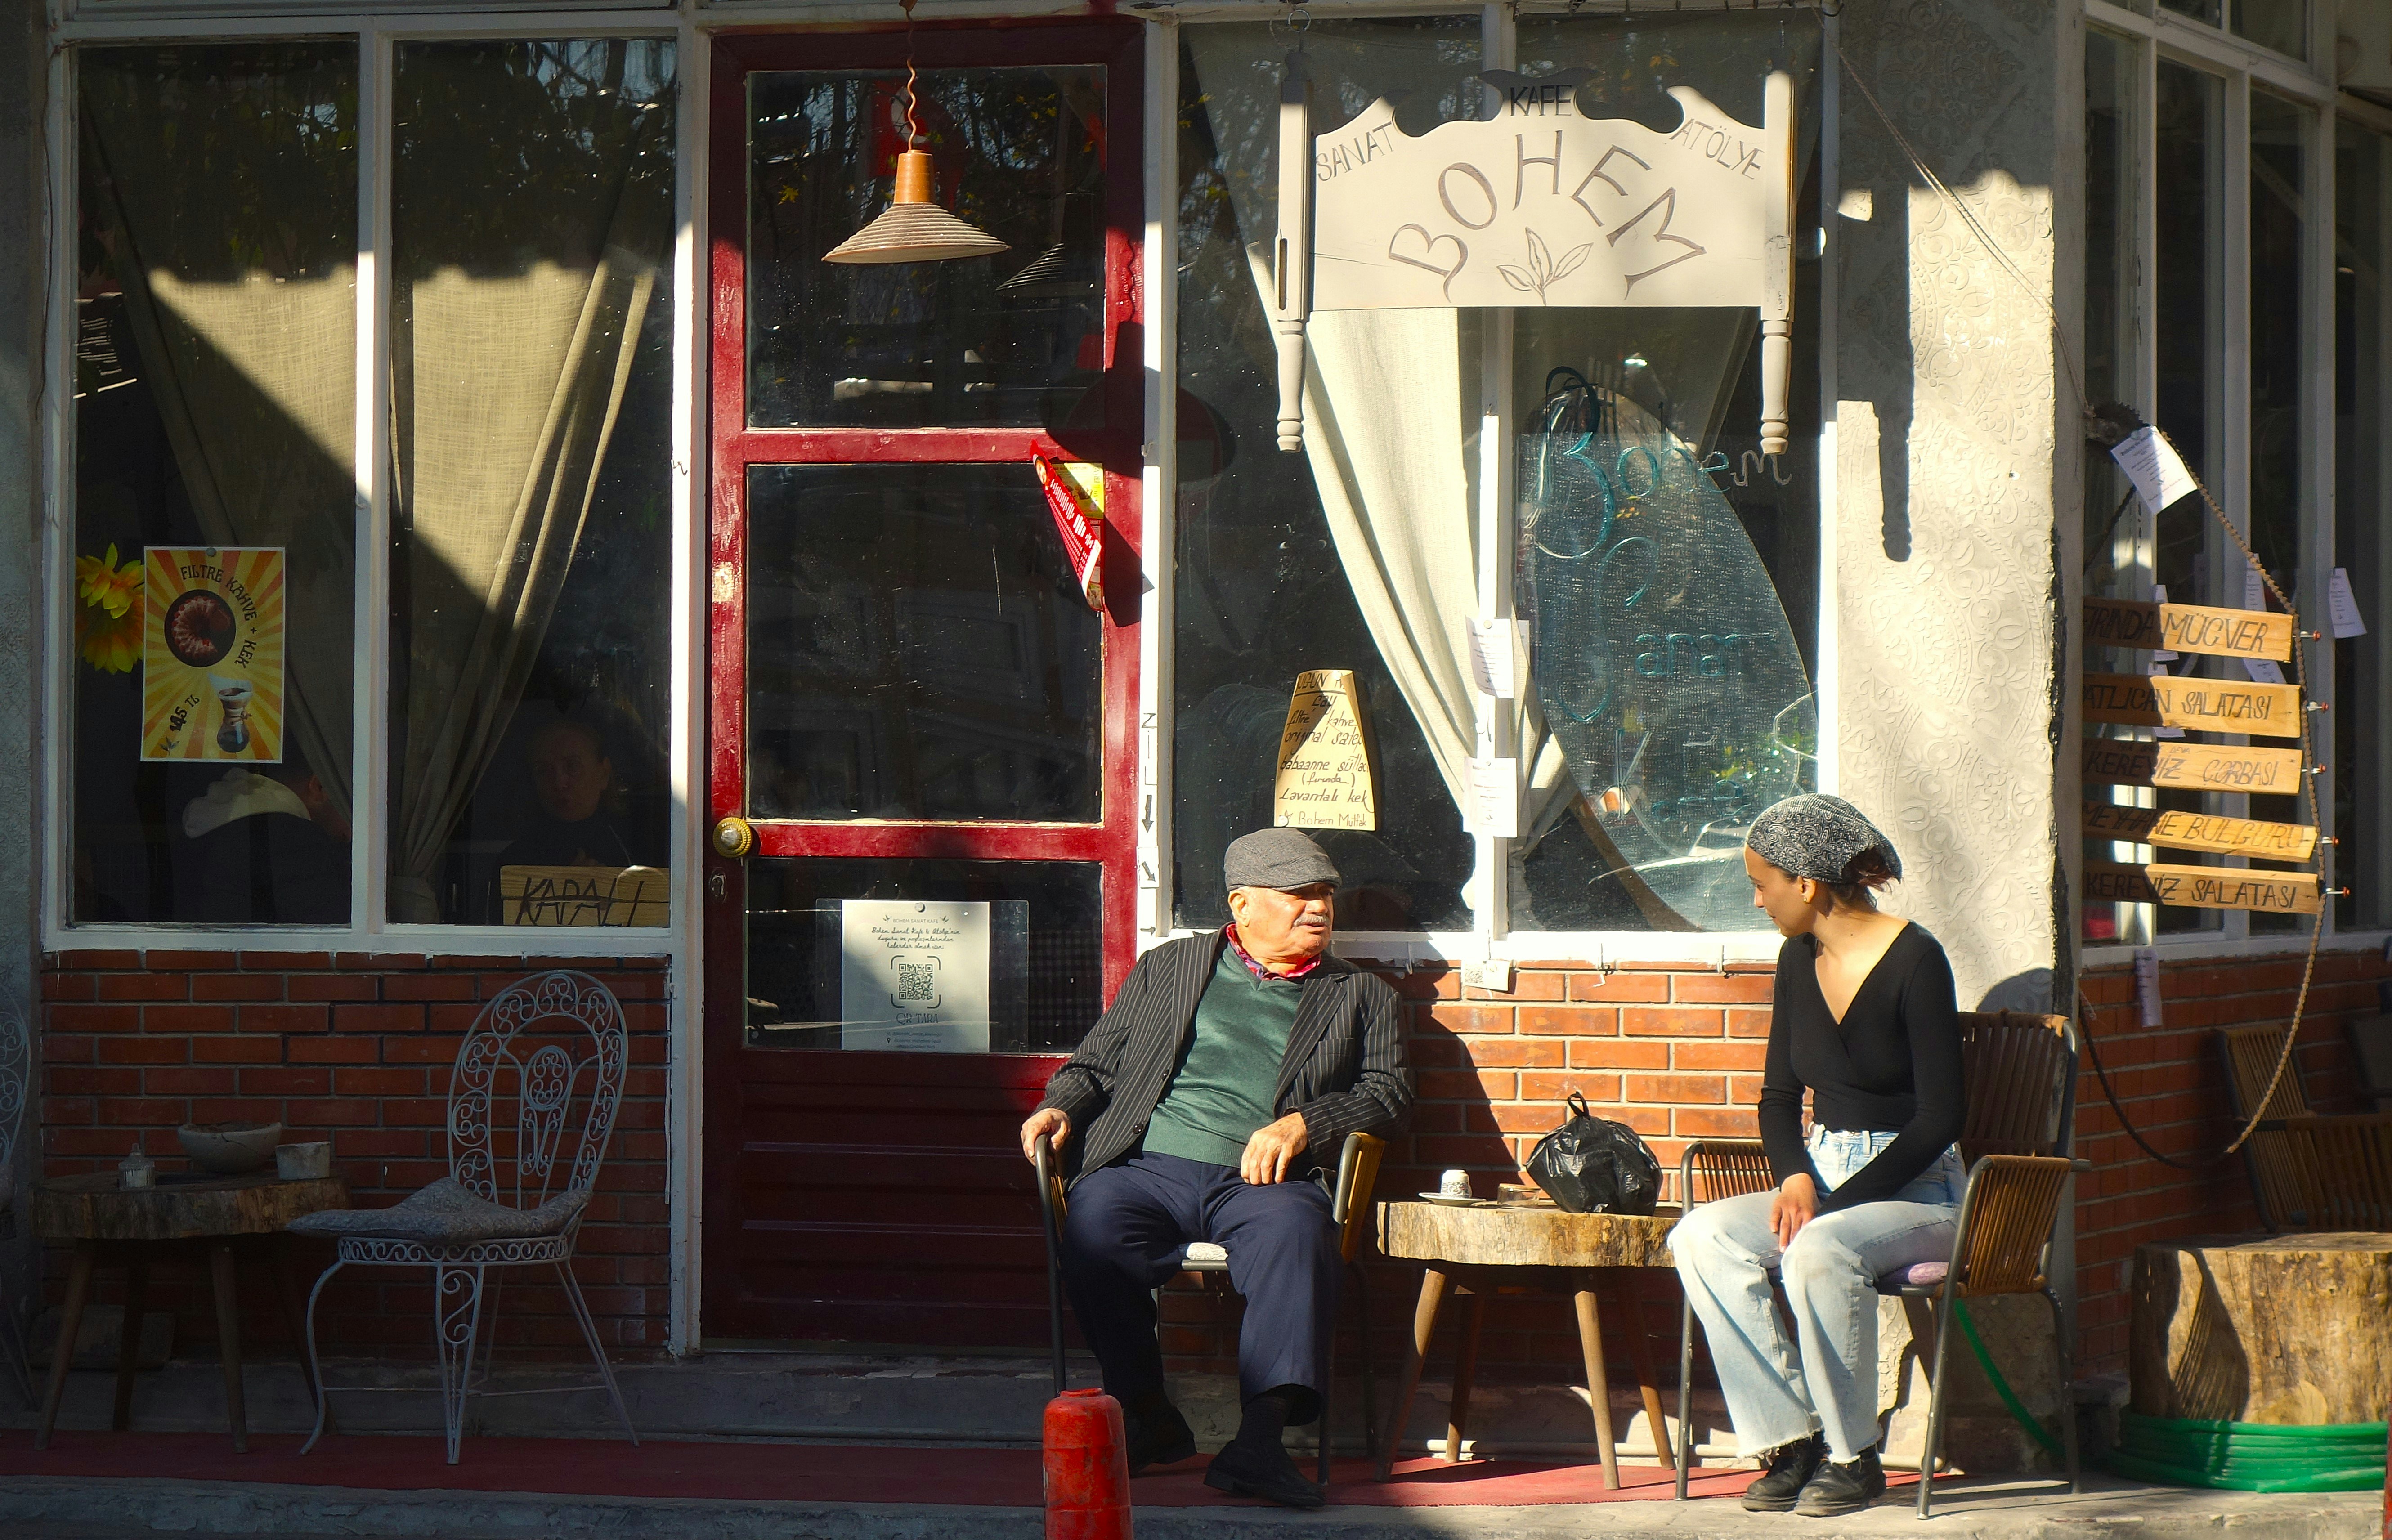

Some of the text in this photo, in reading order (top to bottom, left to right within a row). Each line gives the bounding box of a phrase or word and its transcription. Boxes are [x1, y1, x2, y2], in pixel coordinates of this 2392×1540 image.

[1510, 84, 1574, 117] KAFE
[1315, 120, 1397, 183] SANAT
[1671, 118, 1765, 181] ATÖLYE
[1388, 130, 1706, 302] BOHEM
[225, 577, 257, 621] KAHVE
[234, 639, 257, 669] KEK
[1326, 709, 1359, 731] kahve
[2084, 685, 2273, 721] ATLICAN SALATASI
[1280, 755, 1330, 772] babaanne
[1347, 788, 1374, 813] kek
[1298, 811, 1366, 827] Bohem Mutfak
[514, 877, 645, 927] KAPALI
[2086, 870, 2298, 909] KEREVİZ SALATASI
[896, 1013, 938, 1024] QR TARA
